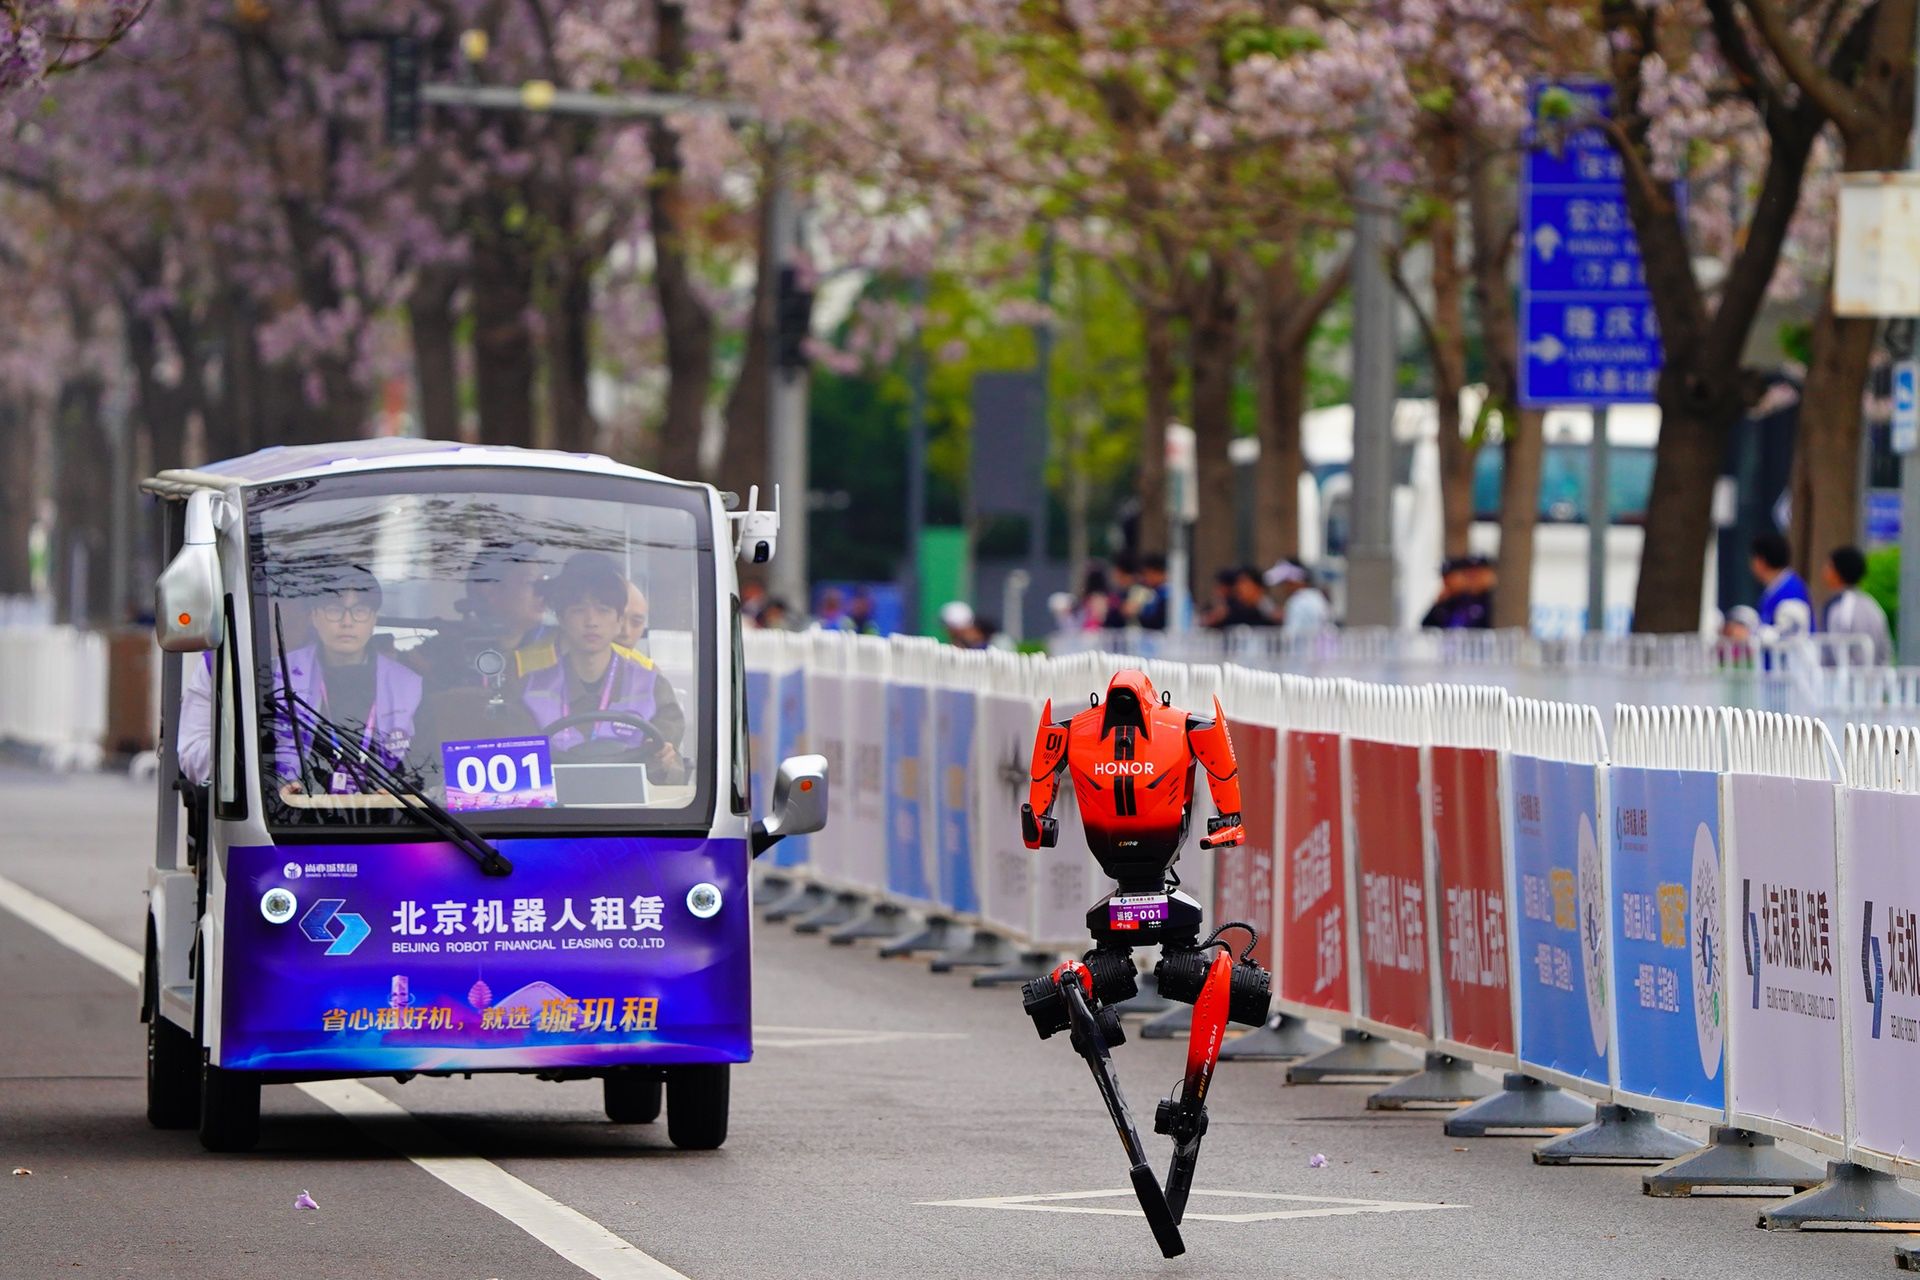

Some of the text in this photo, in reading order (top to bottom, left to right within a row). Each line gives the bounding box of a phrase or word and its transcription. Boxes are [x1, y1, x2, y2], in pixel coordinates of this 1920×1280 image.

[456, 752, 541, 794] 001
[1094, 762, 1154, 775] HONOR
[391, 895, 665, 936] 北京机器人租赁
[1762, 883, 1832, 977] 北京机器人租赁
[392, 942, 440, 953] BEIJING
[446, 941, 489, 952] ROBOT
[494, 939, 556, 951] FINANCIAL
[562, 938, 613, 950] LEASING
